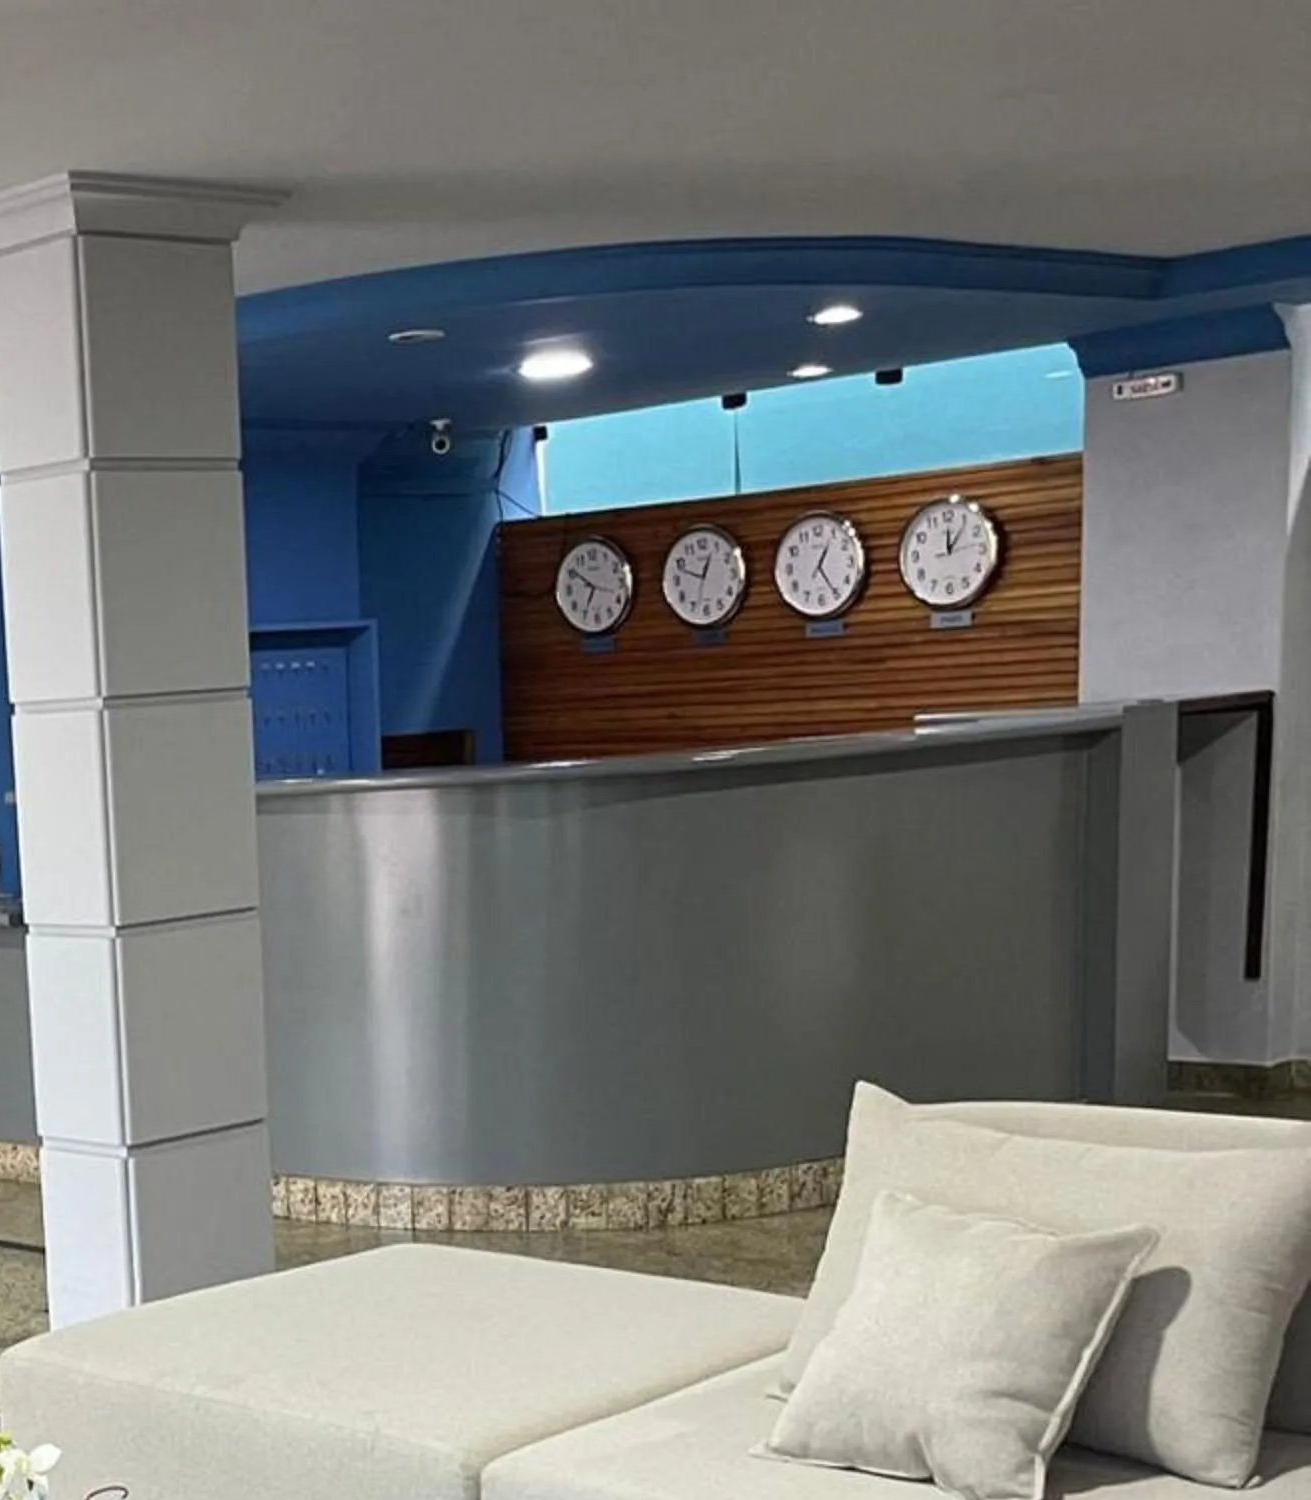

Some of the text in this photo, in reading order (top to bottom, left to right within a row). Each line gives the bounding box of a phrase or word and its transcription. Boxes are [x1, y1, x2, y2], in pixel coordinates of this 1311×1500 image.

[927, 516, 938, 529] 11
[942, 509, 955, 523] 12
[812, 525, 823, 538] 12
[831, 527, 837, 538] 1
[972, 523, 982, 538] 2
[799, 531, 809, 544] 11
[915, 531, 928, 545] 10
[790, 545, 799, 557] 10
[841, 538, 849, 551] 2
[977, 542, 987, 556] 3
[846, 555, 854, 568] 3
[911, 550, 920, 563] 9
[785, 562, 793, 576] 9
[973, 562, 982, 573] 4
[843, 574, 851, 585] 4
[917, 567, 926, 582] 8
[791, 579, 799, 592] 8
[930, 579, 938, 592] 7
[945, 582, 954, 596] 6
[961, 576, 970, 590] 5
[804, 590, 811, 602] 7
[817, 593, 826, 607] 6
